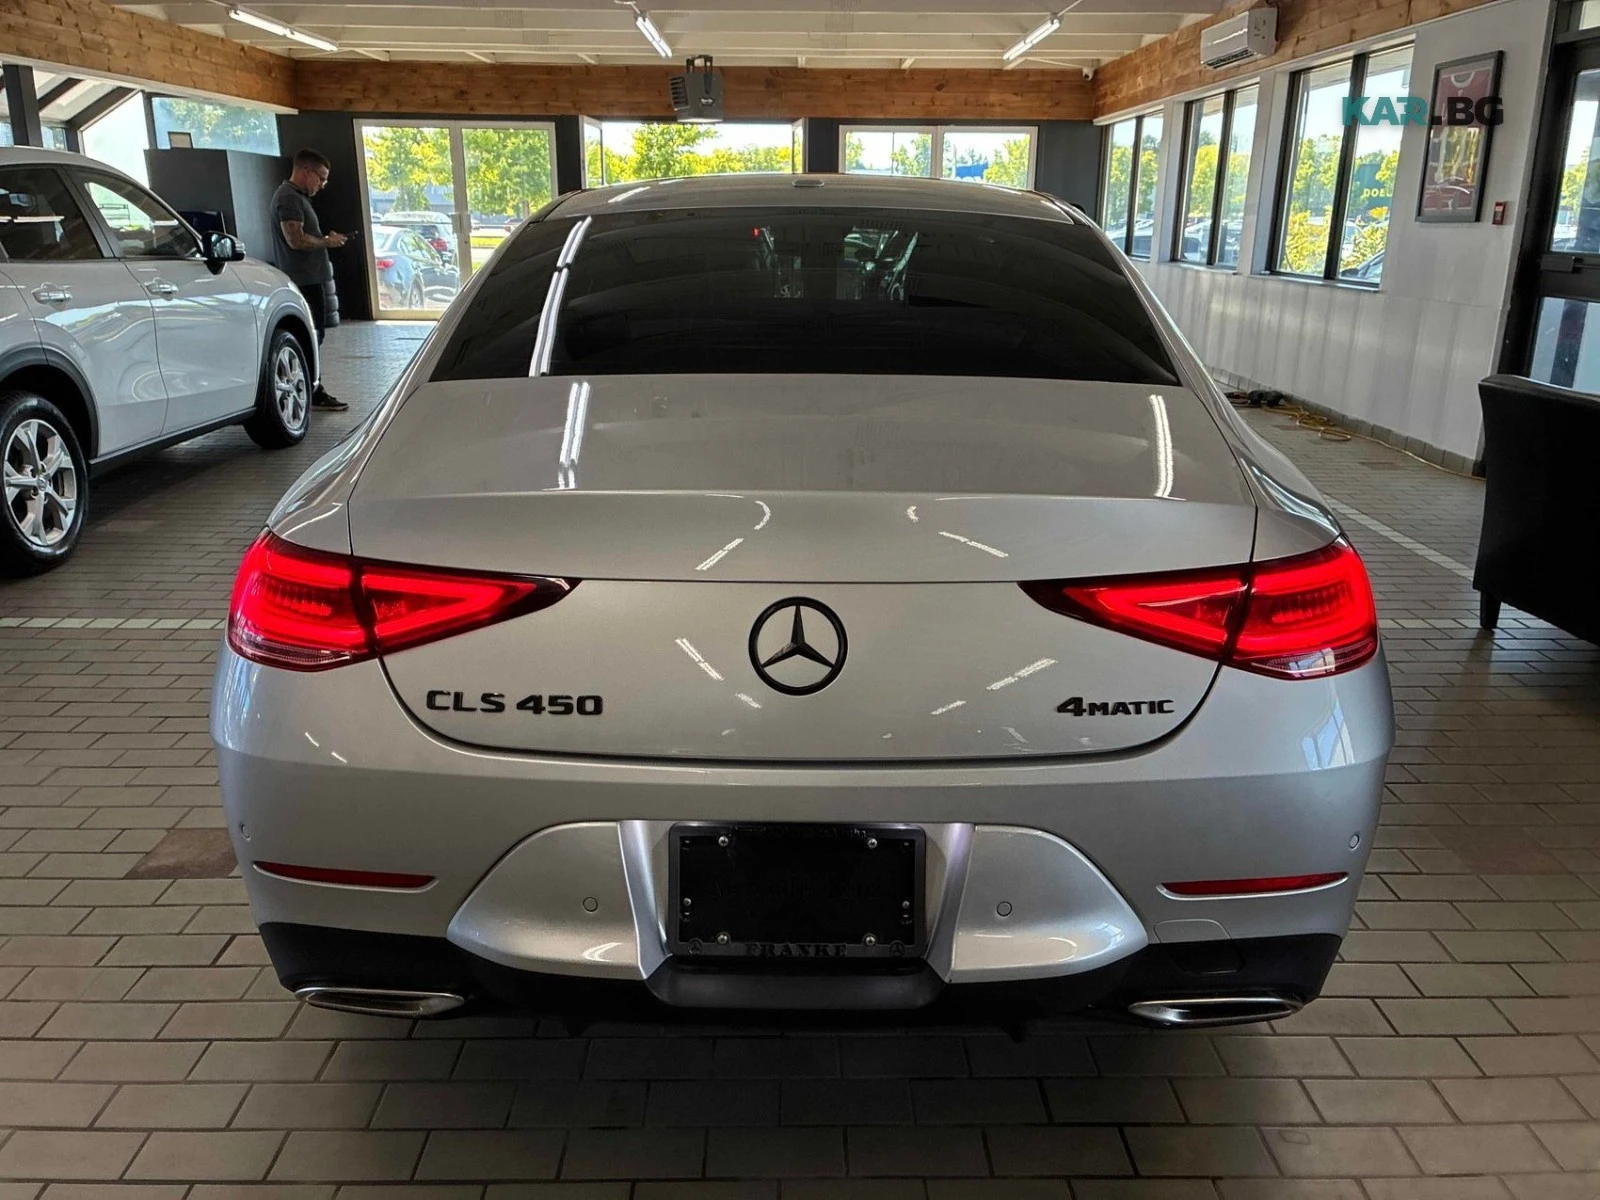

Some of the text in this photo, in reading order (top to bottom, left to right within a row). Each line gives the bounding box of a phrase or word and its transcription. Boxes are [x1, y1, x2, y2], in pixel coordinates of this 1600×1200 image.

[426, 690, 603, 716] CLS 450
[1056, 696, 1175, 717] 4MATIC
[747, 942, 848, 957] FRANKE
